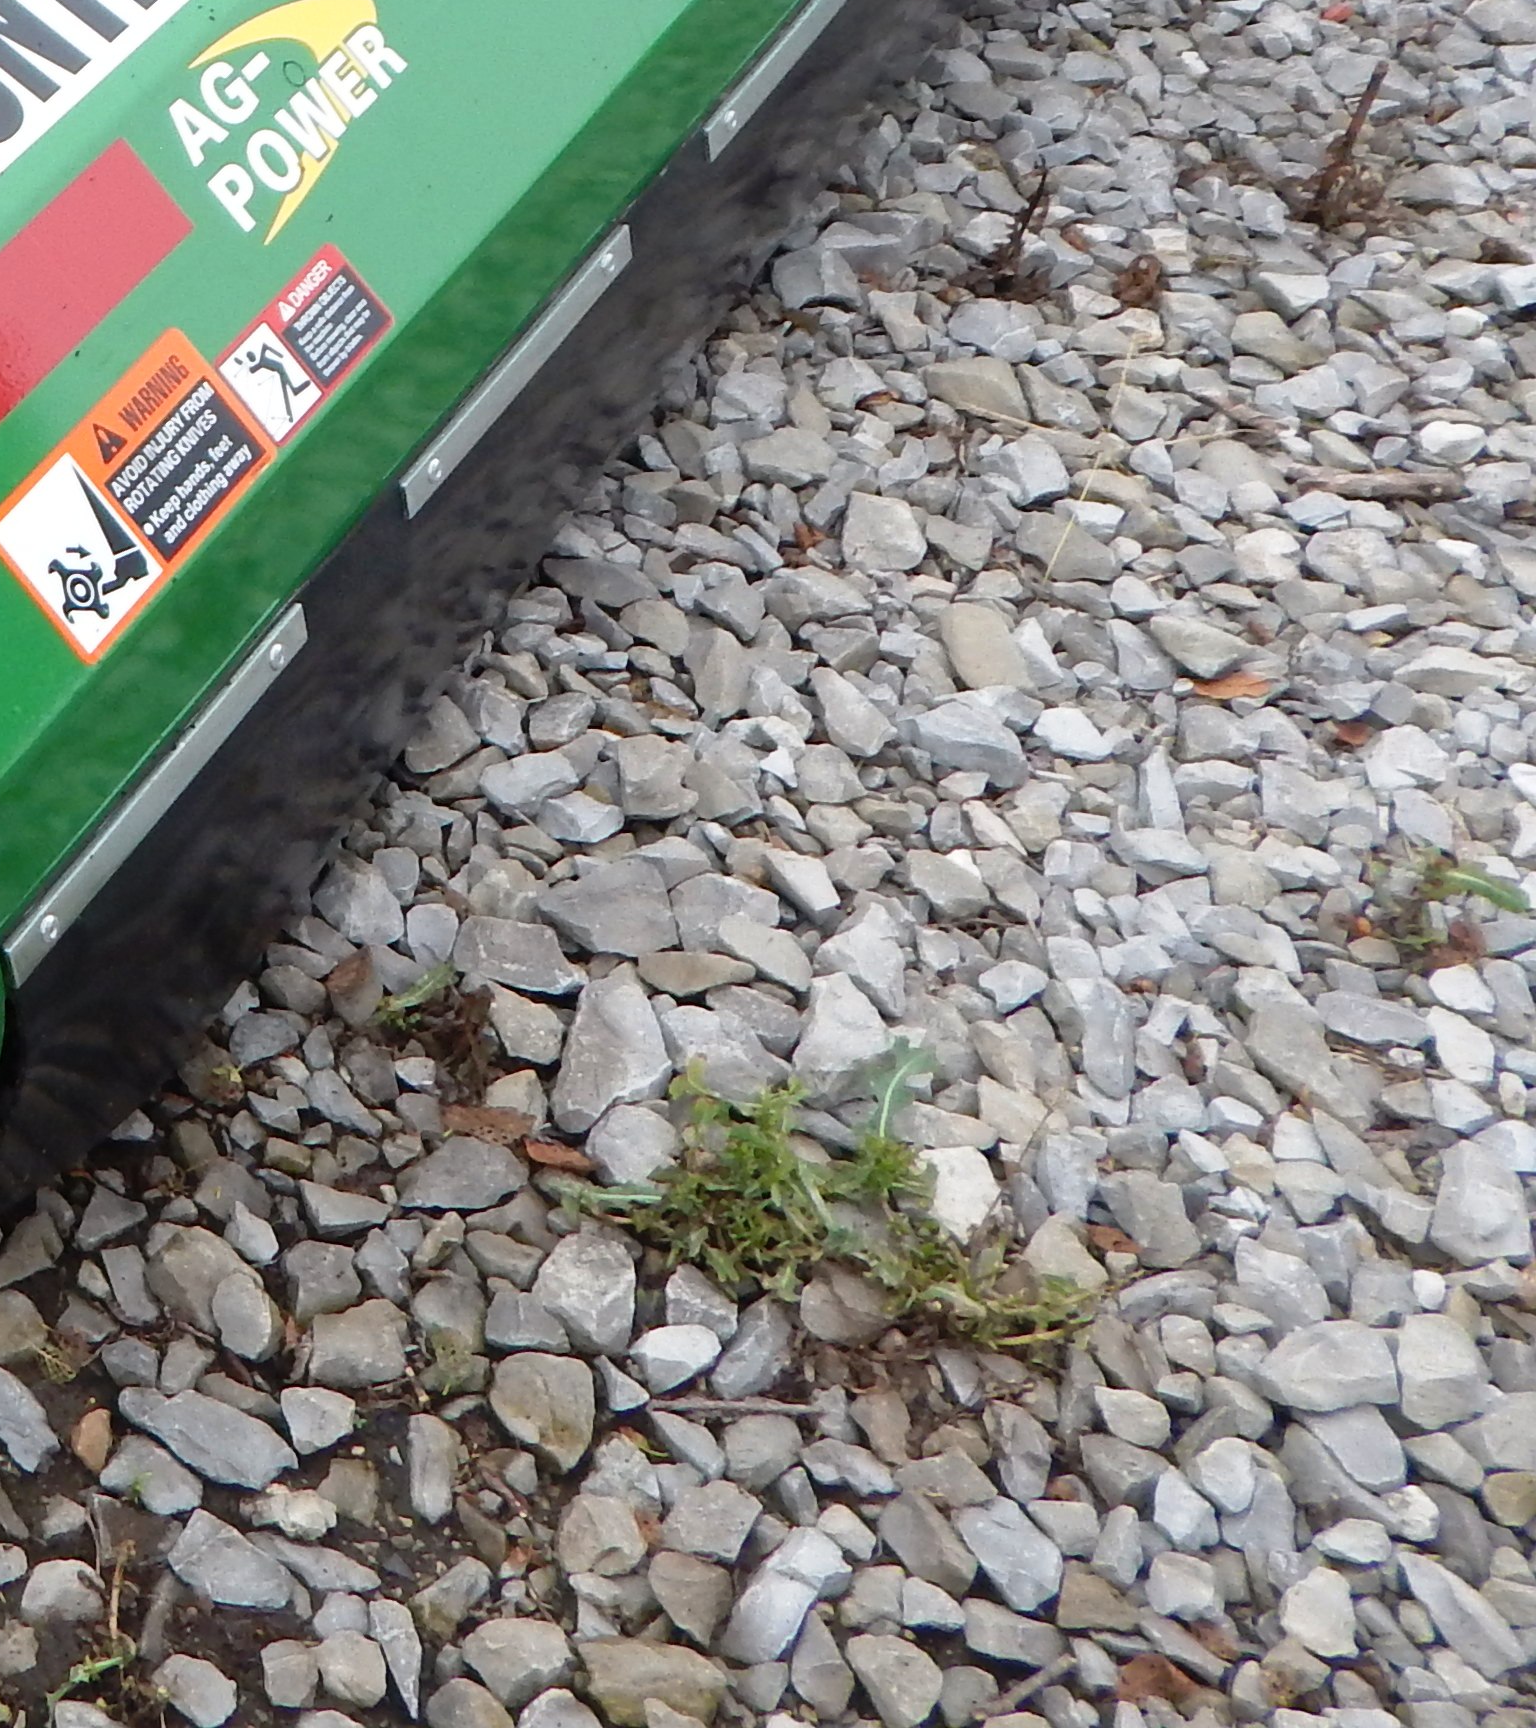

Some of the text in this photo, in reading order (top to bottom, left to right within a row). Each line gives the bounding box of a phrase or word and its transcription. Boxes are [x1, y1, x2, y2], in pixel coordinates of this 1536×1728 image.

[168, 50, 272, 166] AG-
[206, 19, 410, 233] POWER
[288, 259, 333, 308] DANGER
[110, 380, 215, 499] AVOID INJURY FROM
[118, 354, 190, 432] WARNING
[121, 408, 219, 515] ROTATING KNIVES
[150, 432, 234, 529] Keep hands, feet
[163, 442, 253, 545] and clothing away
